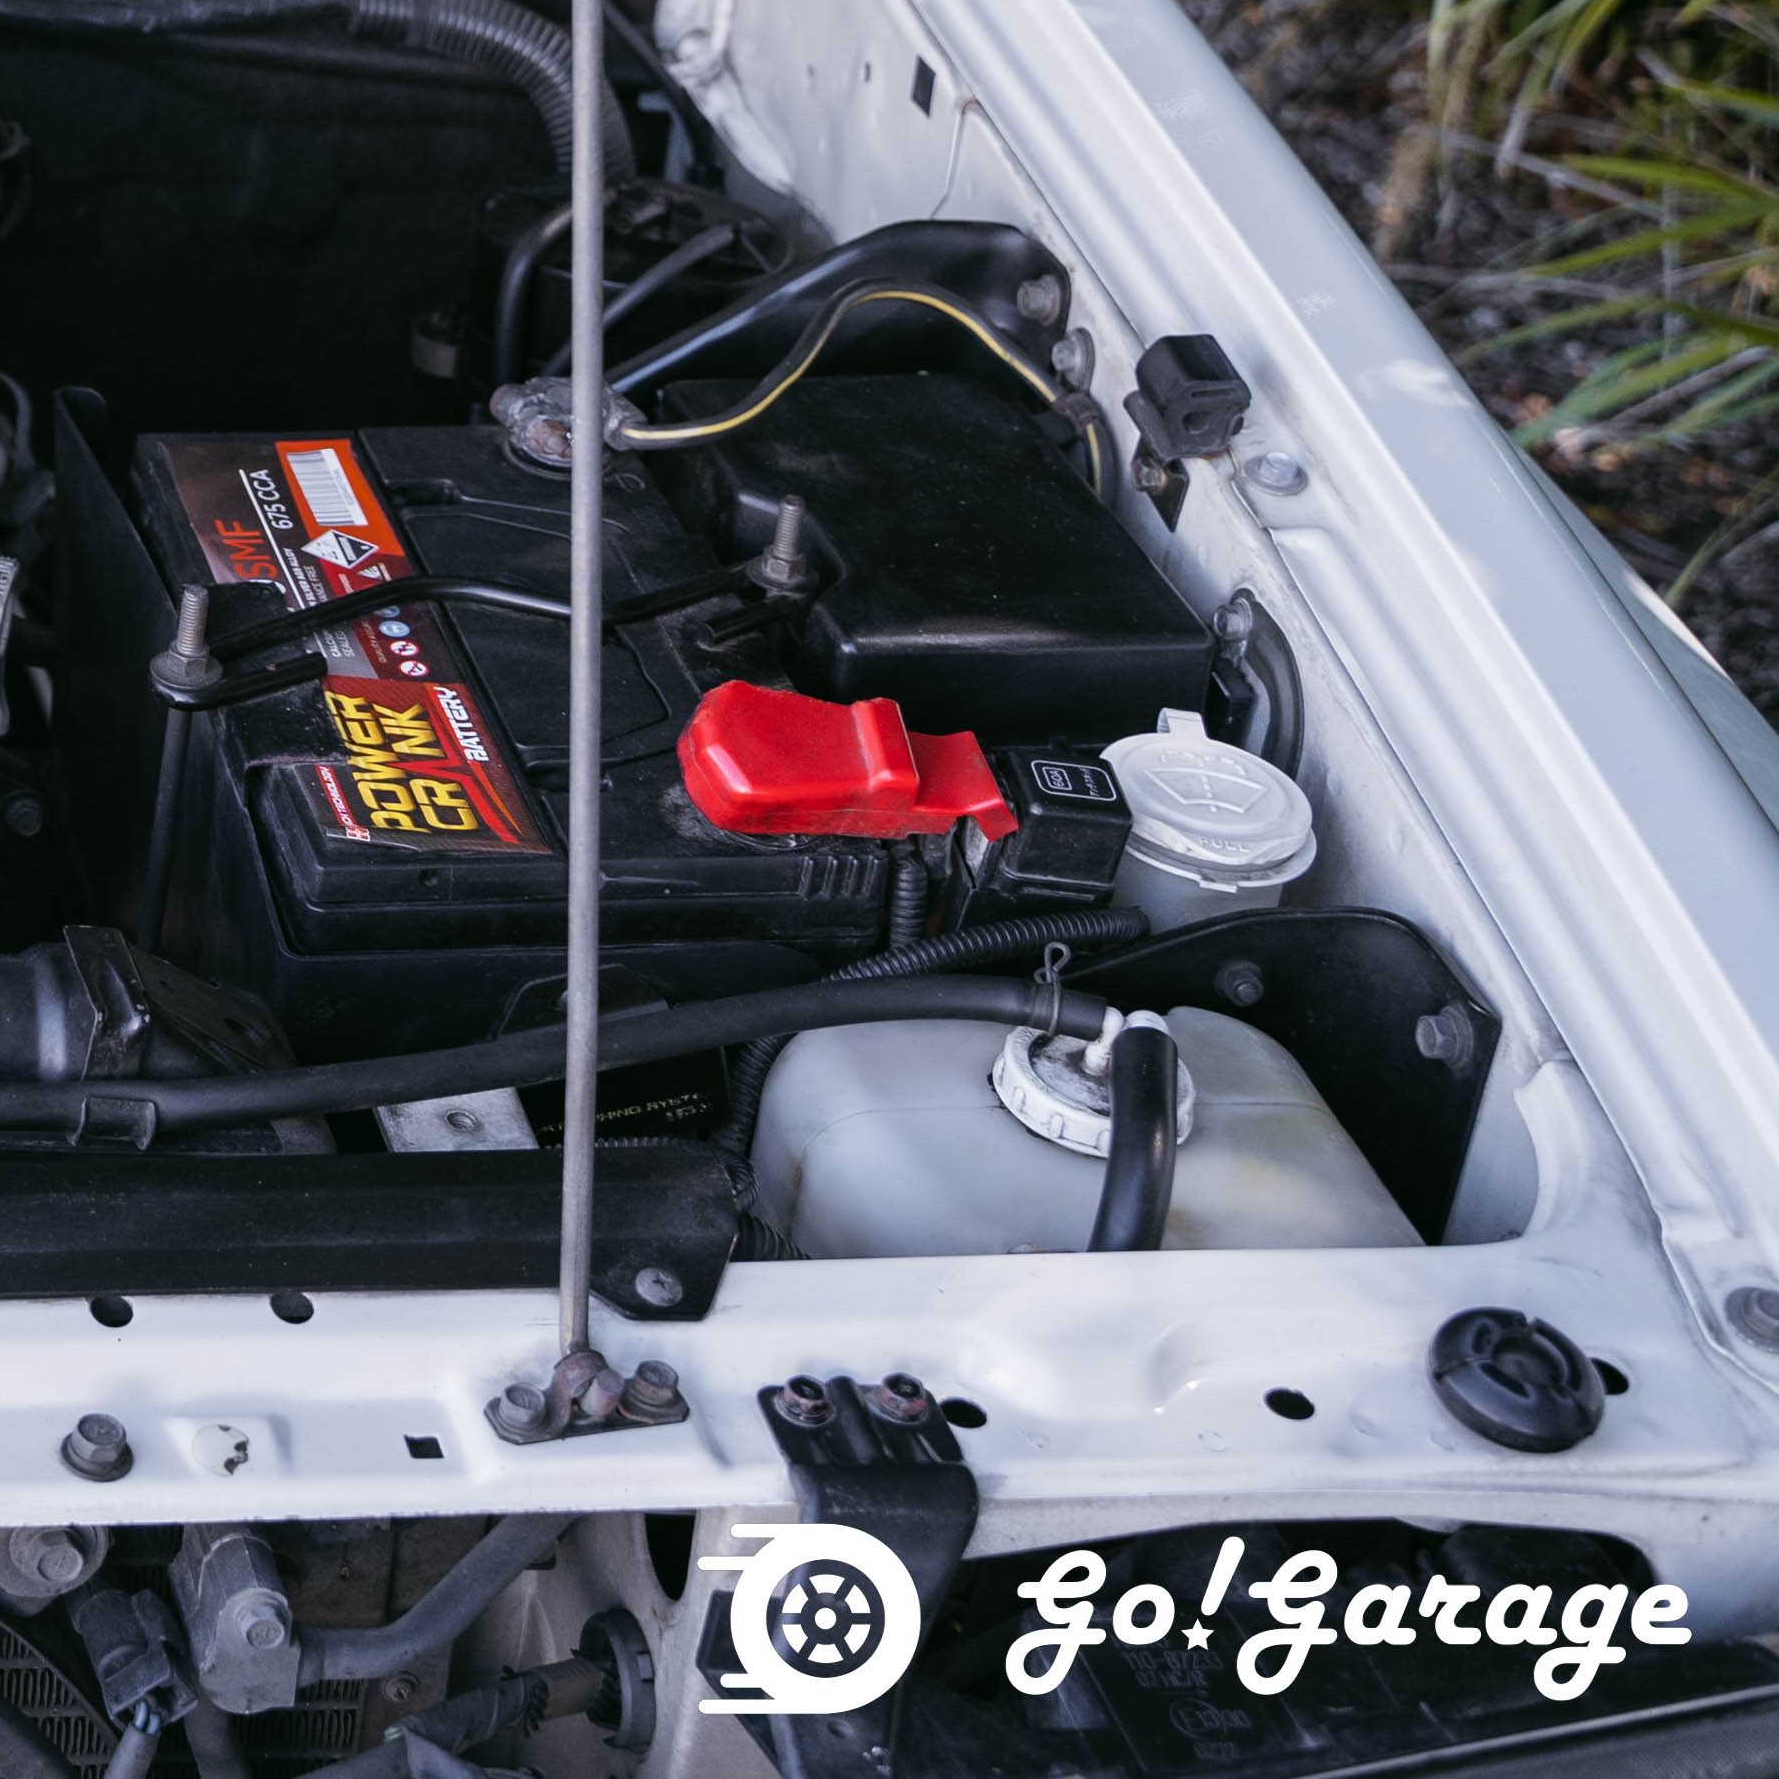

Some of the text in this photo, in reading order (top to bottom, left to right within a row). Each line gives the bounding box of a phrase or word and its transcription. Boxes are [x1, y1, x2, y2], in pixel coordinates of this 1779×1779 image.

[249, 468, 295, 530] 675 CCA
[323, 690, 431, 834] POWER
[432, 685, 490, 762] BATTERY
